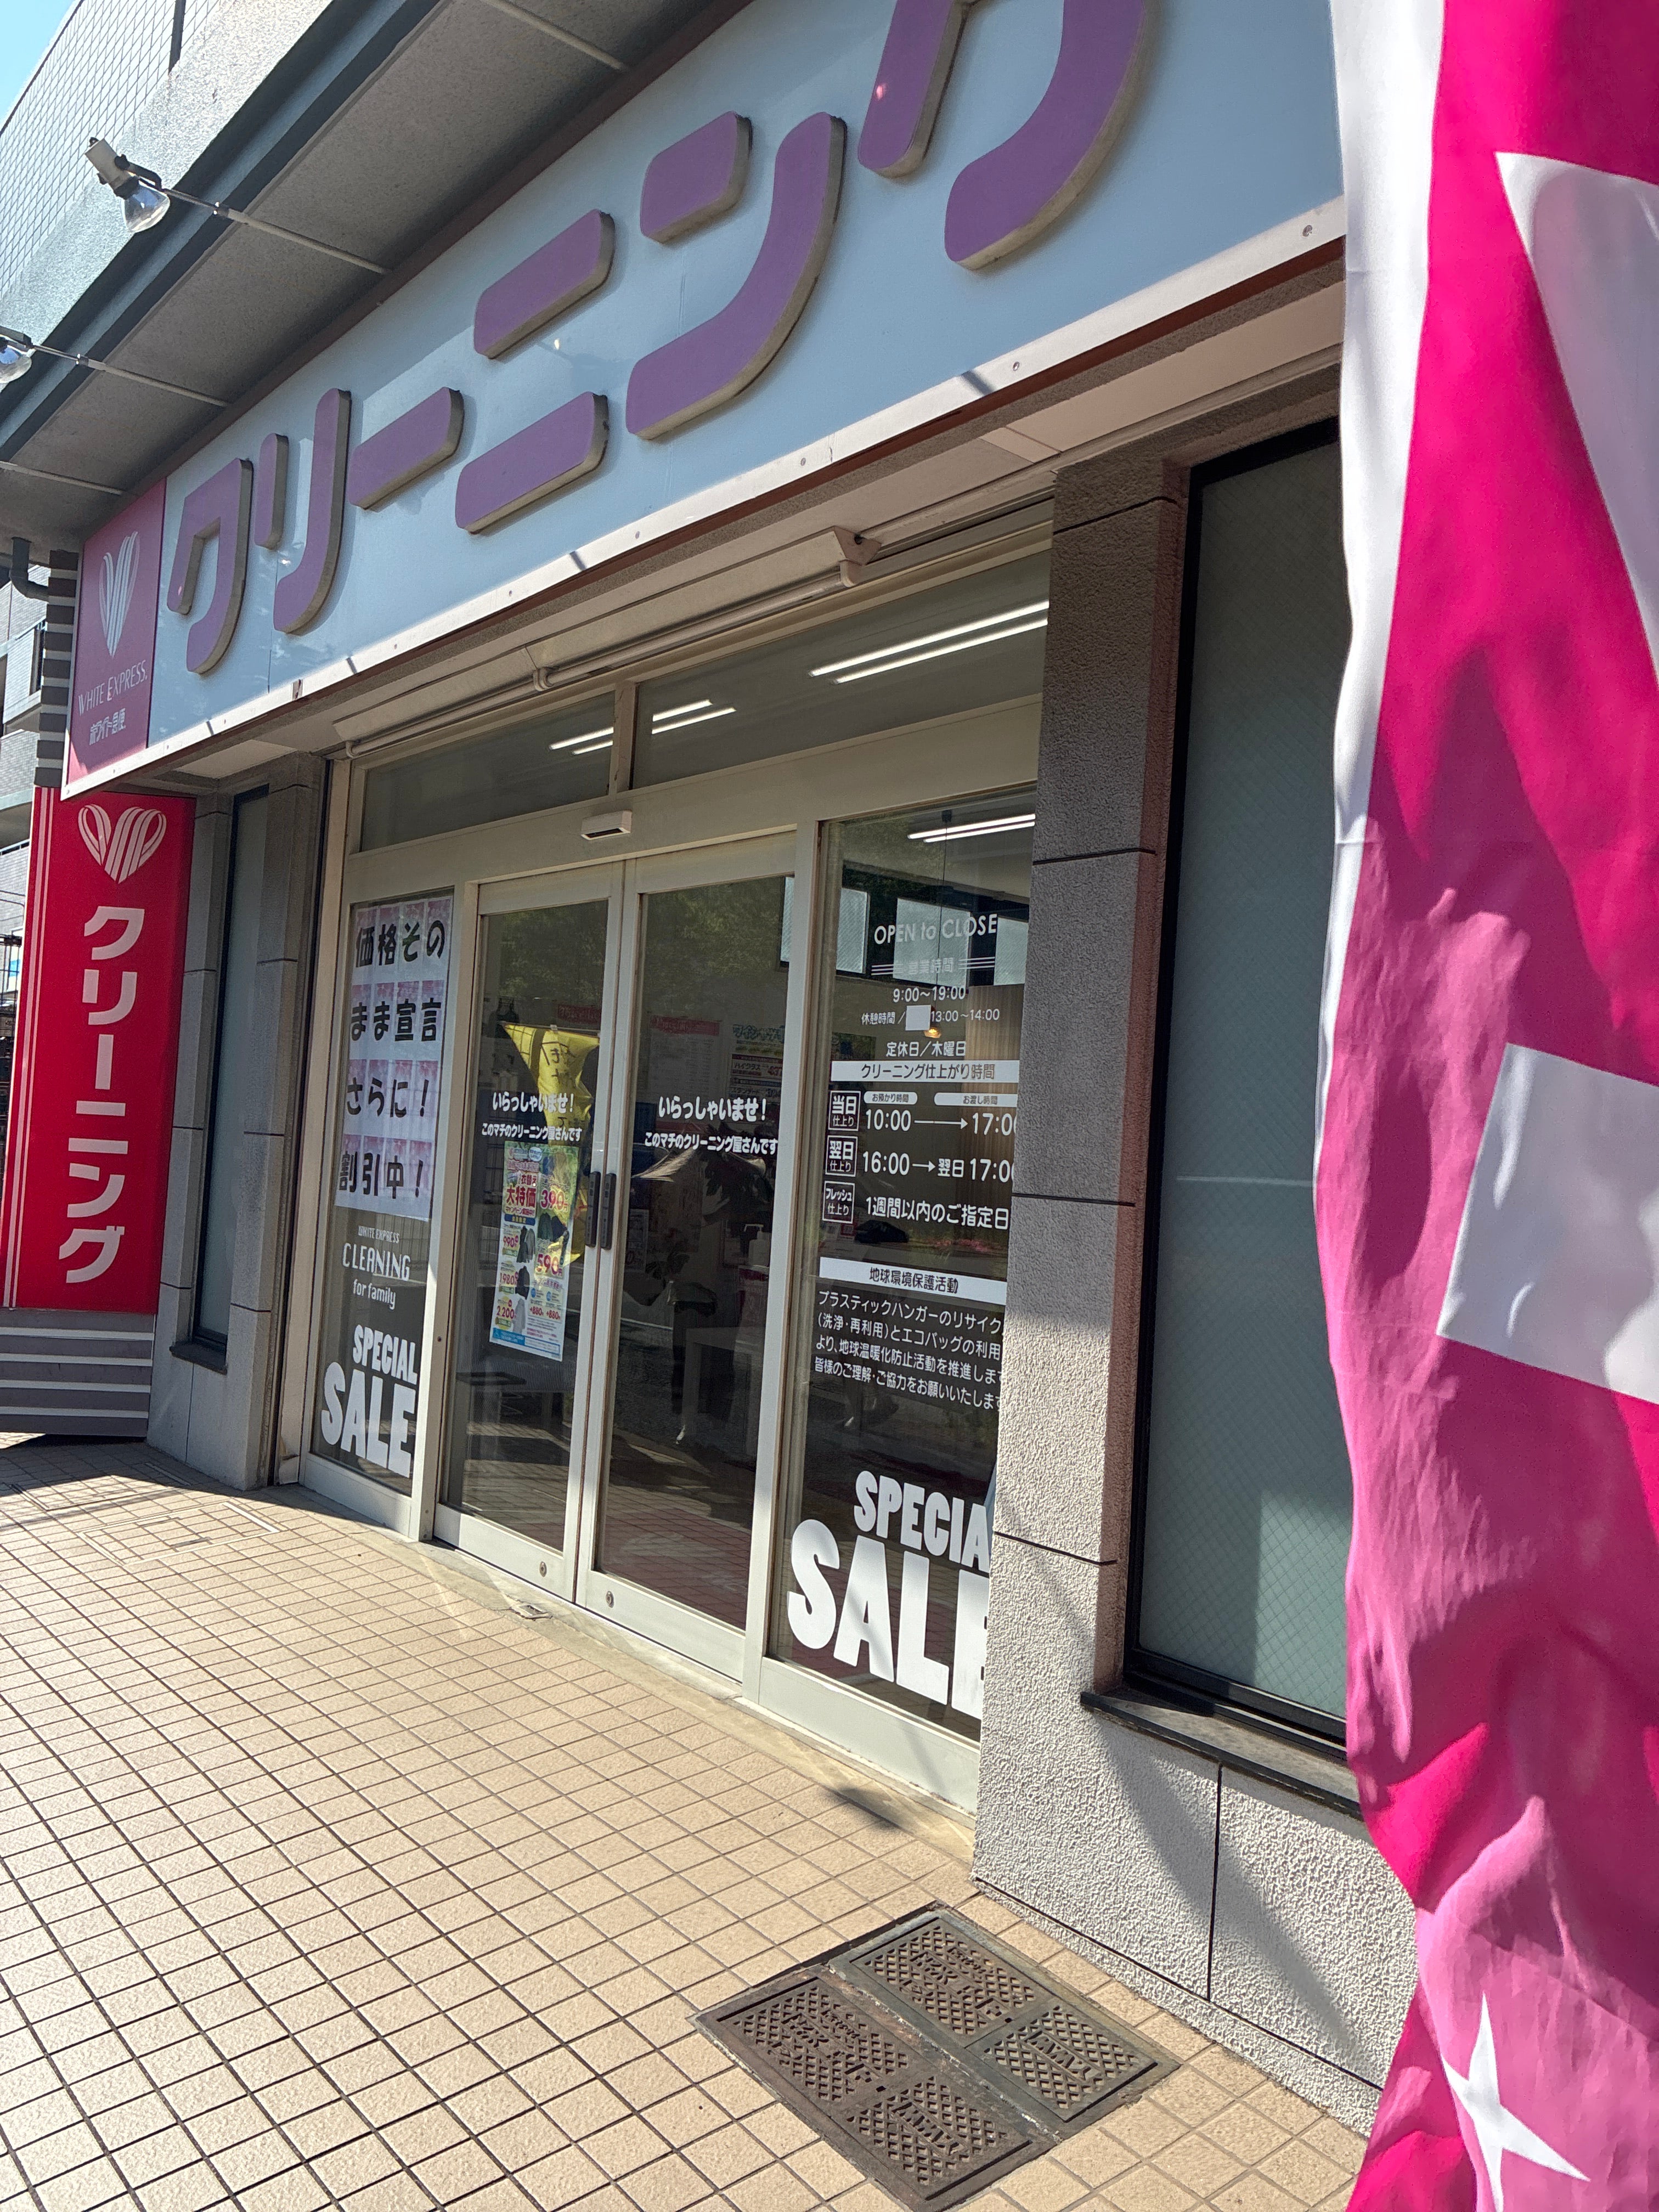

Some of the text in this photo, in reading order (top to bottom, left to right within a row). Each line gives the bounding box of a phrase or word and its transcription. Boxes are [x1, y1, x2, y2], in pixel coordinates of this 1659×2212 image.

[78, 682, 105, 715] WHITE
[873, 913, 998, 945] OPEN to CLOSE
[356, 919, 445, 968] 価格その
[909, 957, 954, 975] 営業時間
[351, 997, 441, 1041] まま宣言
[861, 1063, 996, 1081] クリーニング仕上がり時間
[59, 906, 145, 1283] クリーニング
[832, 1095, 857, 1115] 当日
[872, 1094, 909, 1103] お預かり時間
[963, 1096, 998, 1105] お渡し時間
[832, 1115, 854, 1127] 仕上り
[865, 1109, 911, 1131] 10:00
[972, 1113, 1017, 1136] 17:0
[481, 1123, 583, 1142] このマチのクリーニング屋さんです
[645, 1132, 778, 1155] このマチのクリーニング屋さんです
[829, 1140, 854, 1160] 翌日
[830, 1160, 851, 1172] 仕上り
[862, 1151, 910, 1175] 16:00
[937, 1158, 1014, 1183] 翌日 17:0
[506, 1186, 537, 1208] 大特価
[826, 1188, 852, 1201] フレッシュ
[827, 1203, 849, 1216] 仕上り
[865, 1197, 1009, 1230] 1週間以内のご指定日
[358, 1225, 375, 1239] WHITE
[342, 1243, 410, 1281] CLEANING
[870, 1267, 958, 1294] 地球環境保護活動
[352, 1279, 396, 1310] for family
[353, 1324, 417, 1385] SPECIAL
[321, 1361, 416, 1478] SALE
